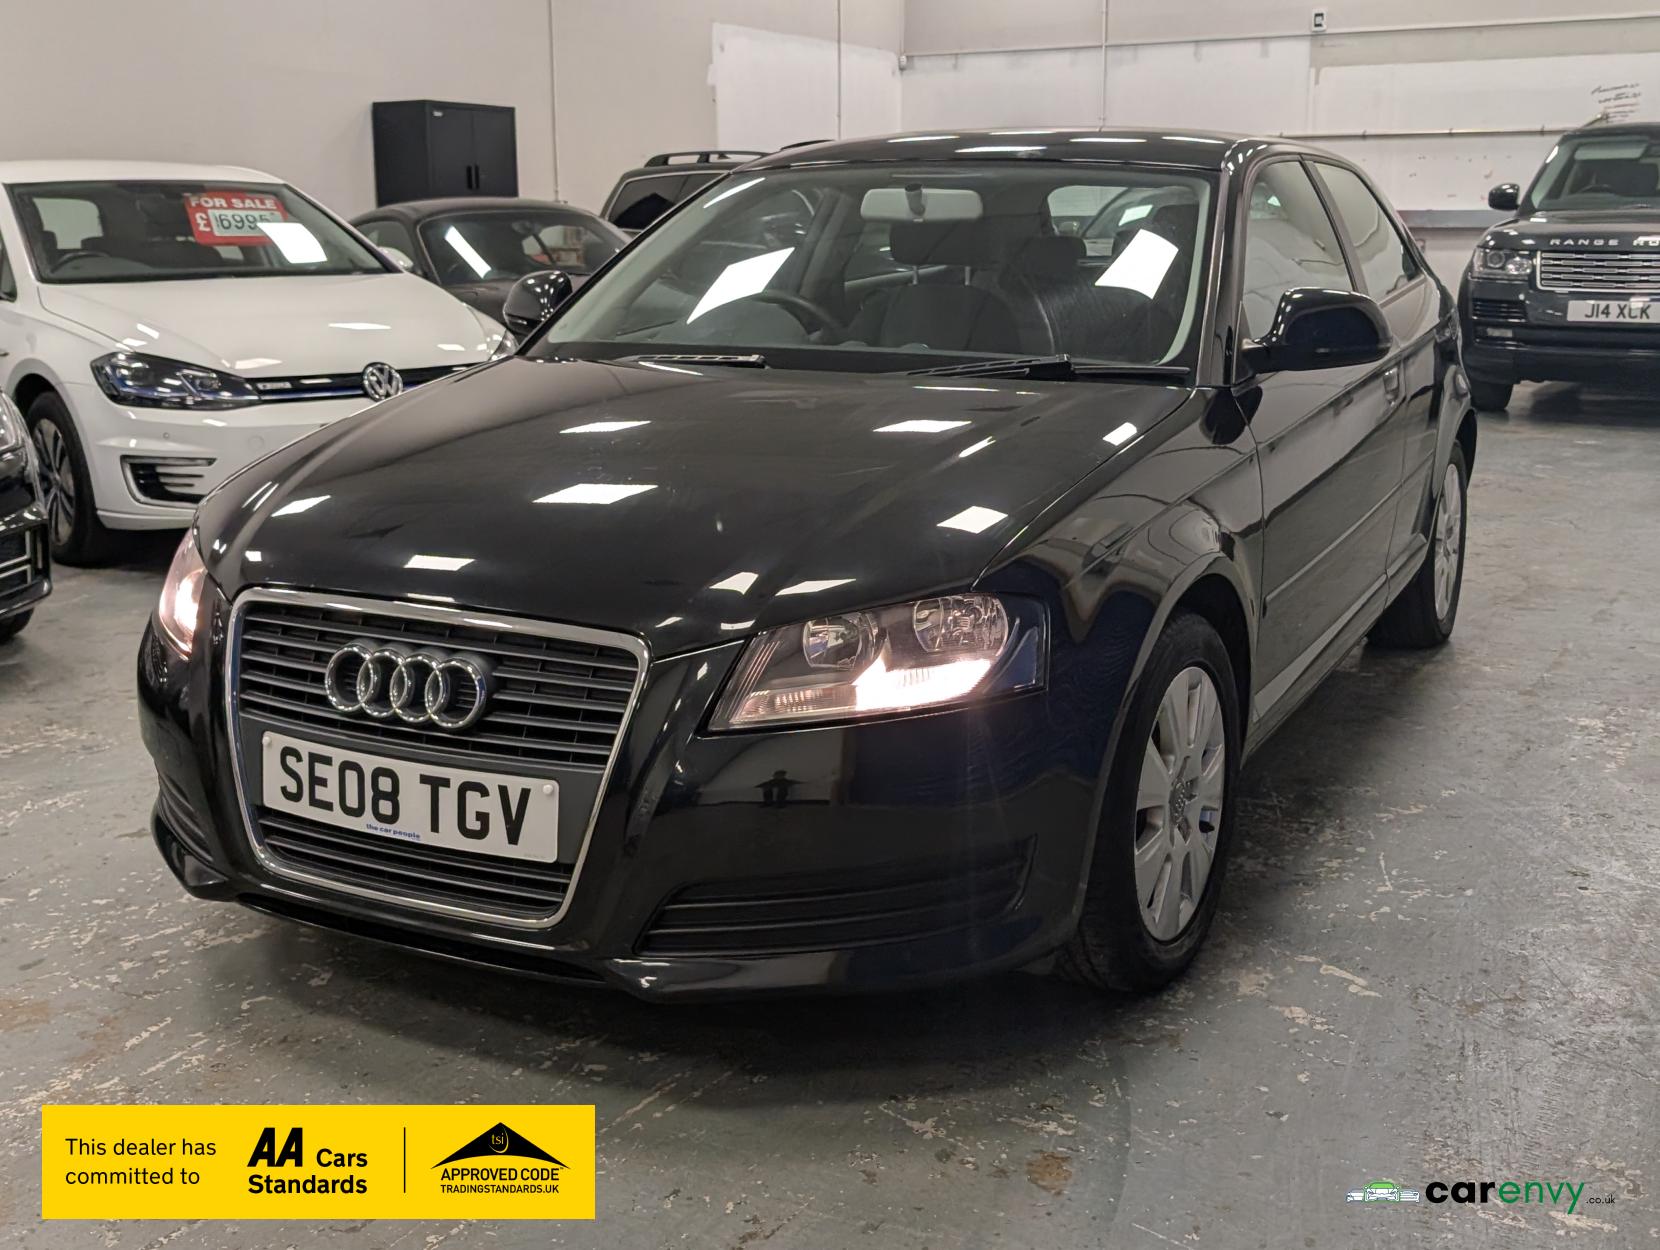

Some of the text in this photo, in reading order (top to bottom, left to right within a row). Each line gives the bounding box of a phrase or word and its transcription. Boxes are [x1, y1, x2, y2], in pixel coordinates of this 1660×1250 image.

[189, 197, 278, 210] FOR SALE
[1549, 238, 1620, 246] RANGE
[1584, 303, 1611, 318] J14
[280, 746, 532, 846] SE08 TGV
[366, 823, 379, 832] the
[393, 830, 421, 840] people
